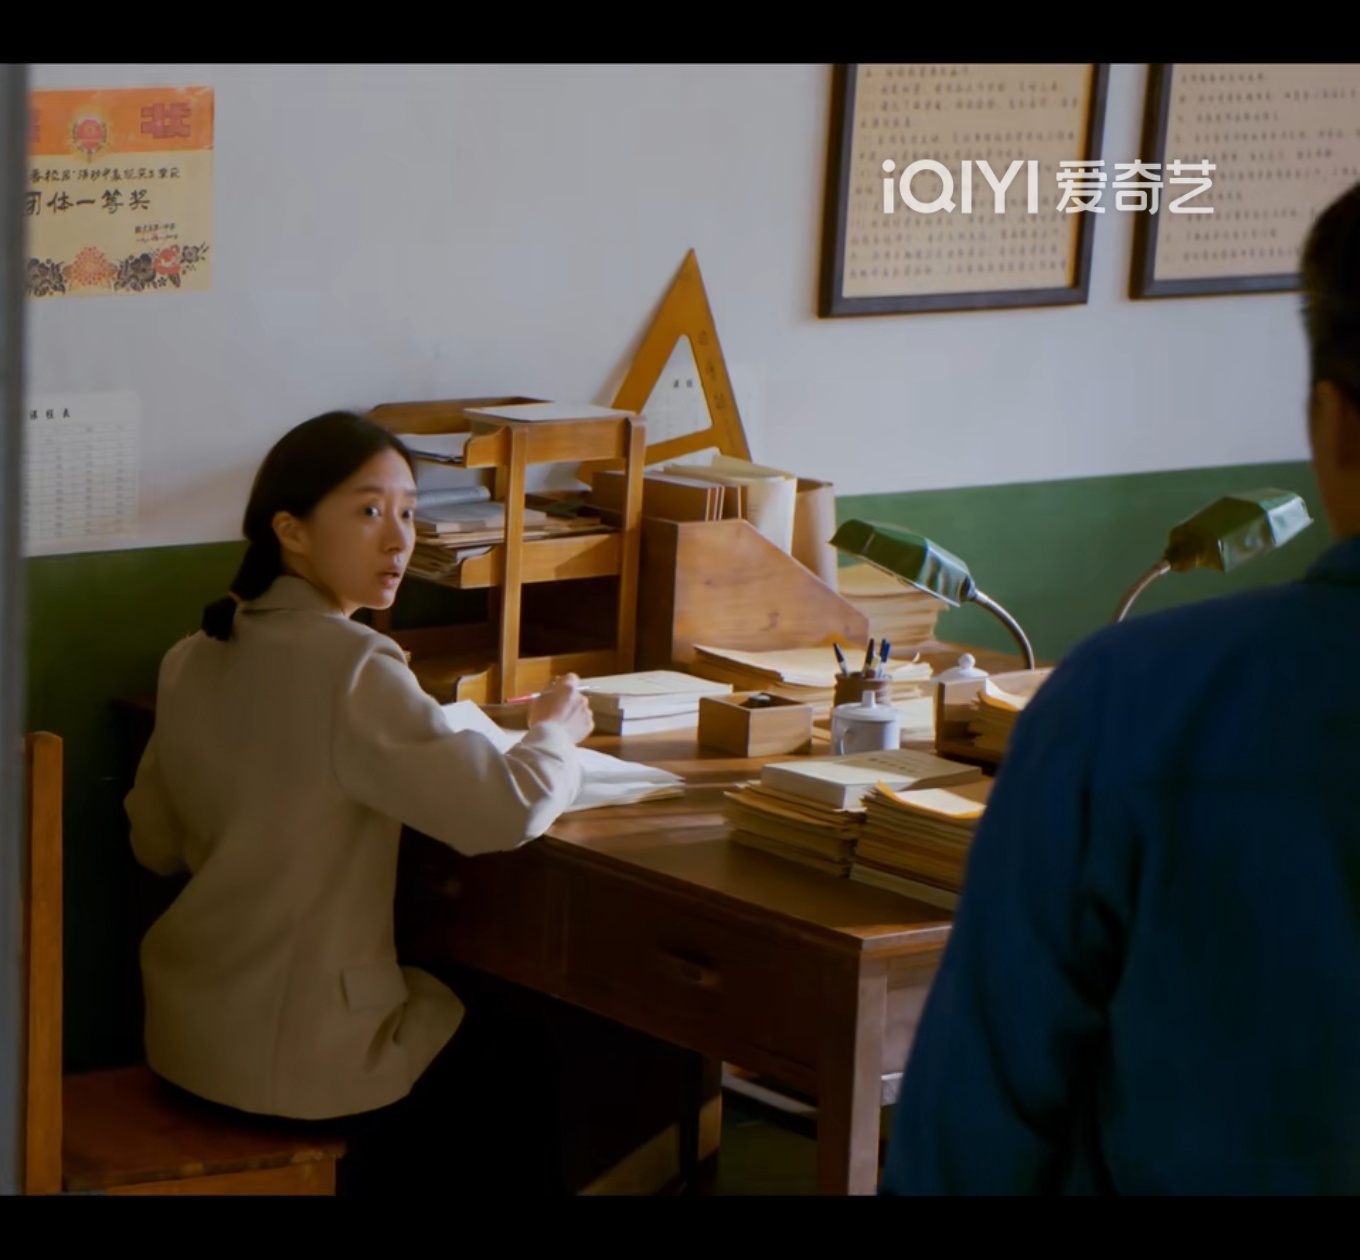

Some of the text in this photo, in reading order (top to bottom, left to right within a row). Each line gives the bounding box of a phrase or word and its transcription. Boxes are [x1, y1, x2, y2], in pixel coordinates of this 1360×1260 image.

[26, 188, 150, 216] 团体一等奖
